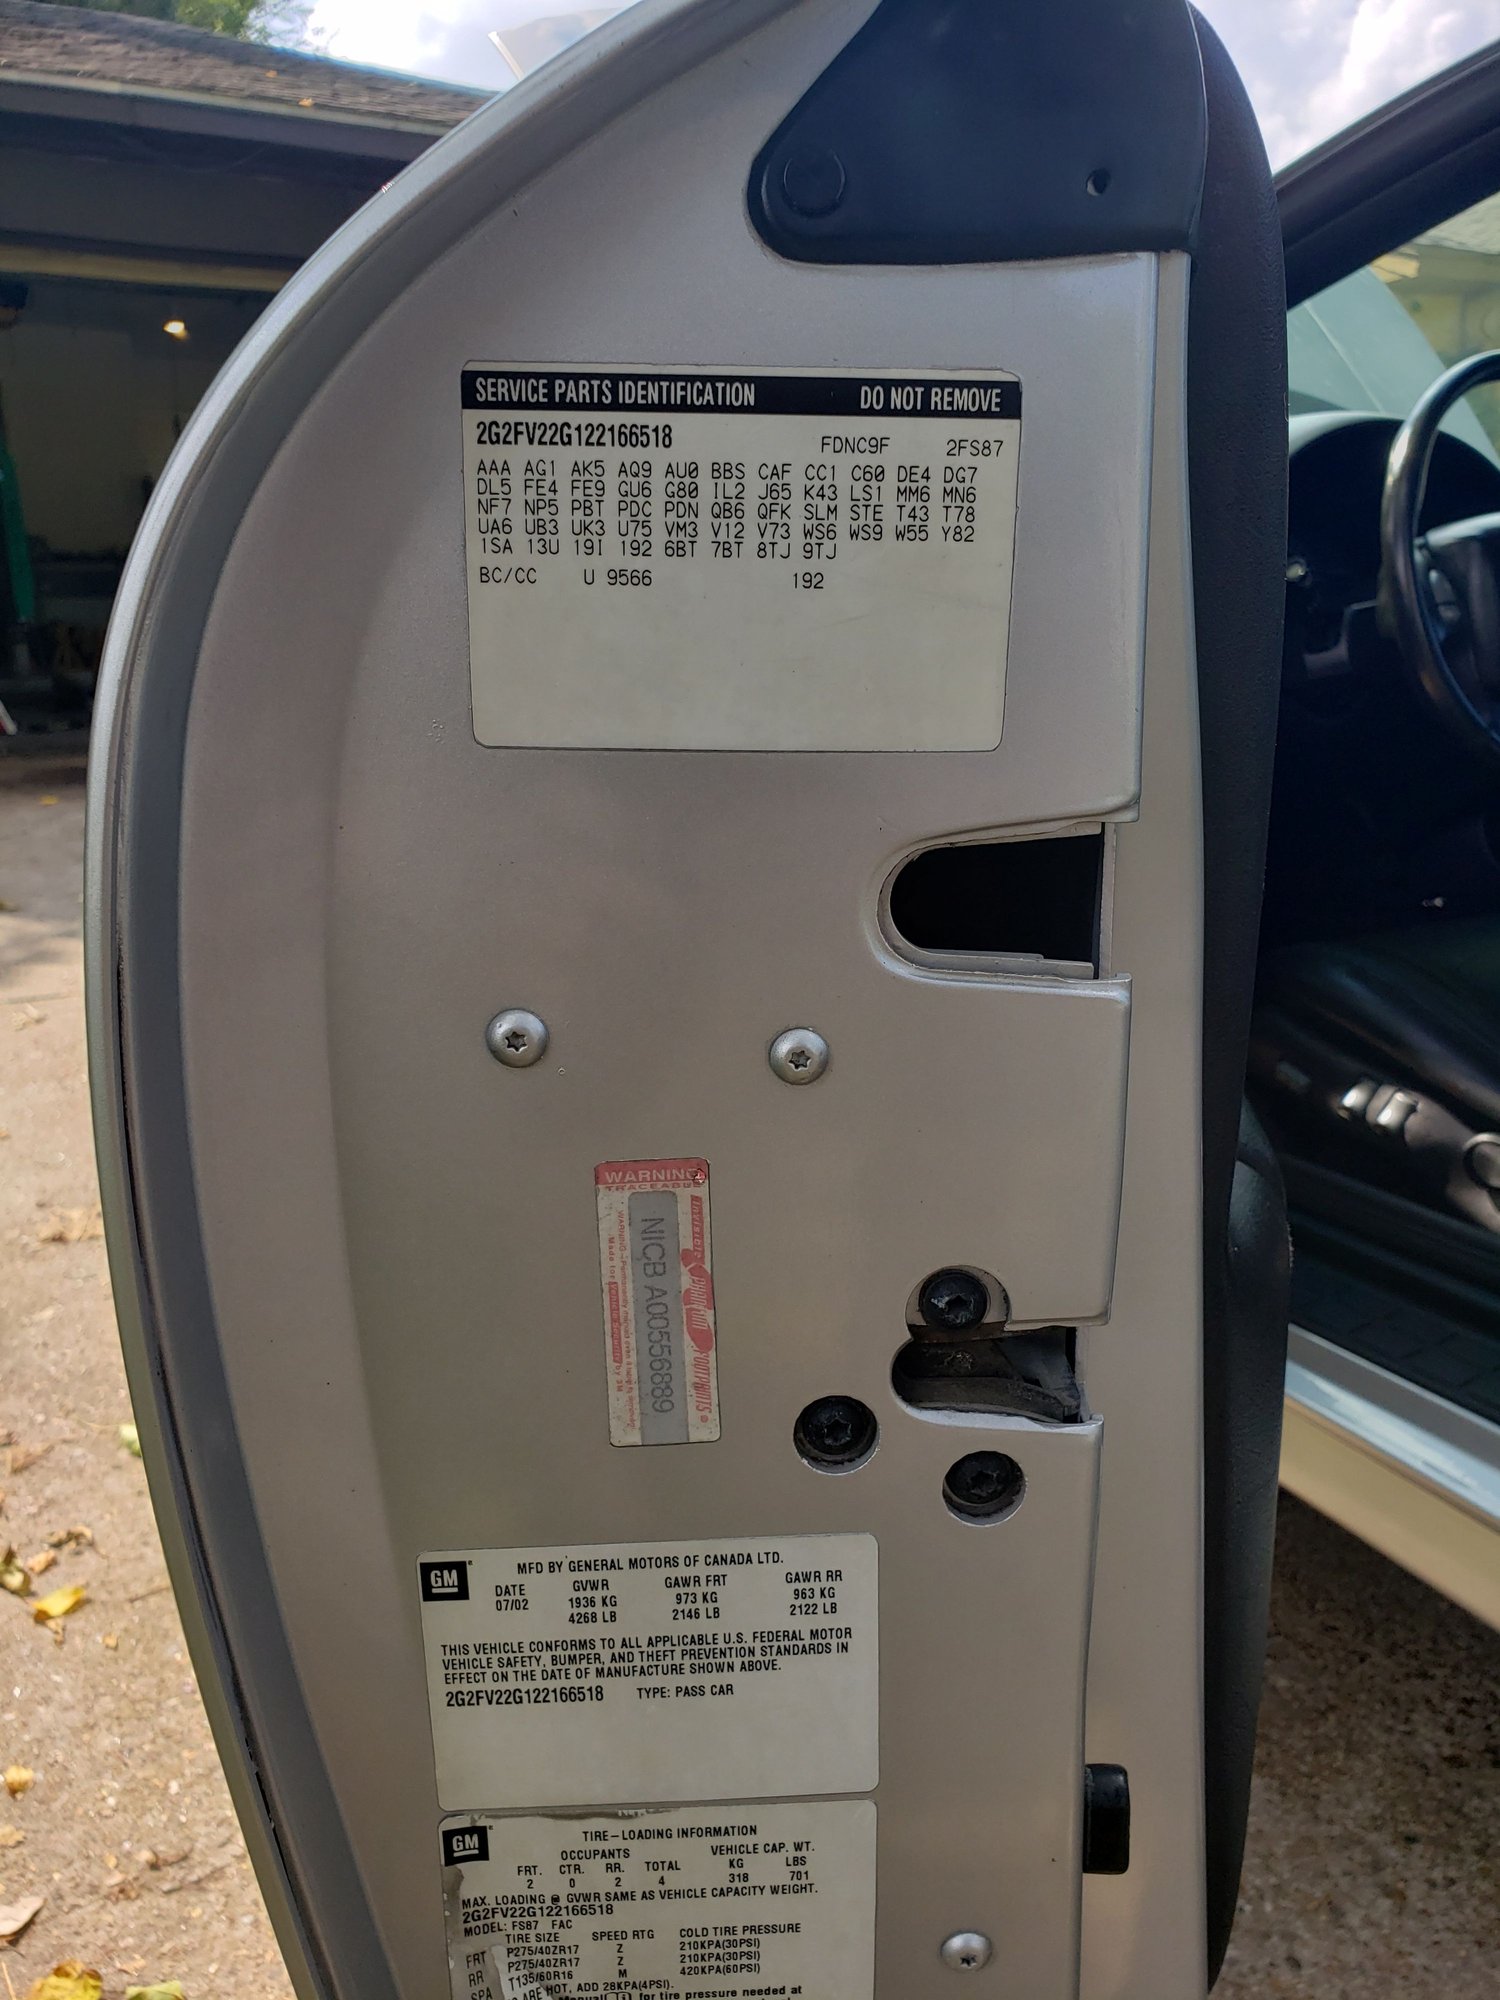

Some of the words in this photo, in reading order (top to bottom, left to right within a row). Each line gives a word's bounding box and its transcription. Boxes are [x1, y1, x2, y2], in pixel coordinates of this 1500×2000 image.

[476, 378, 548, 403] SERVICE
[554, 379, 612, 404] PARTS
[618, 381, 755, 406] IDENTIFICATION
[860, 385, 884, 410] DO
[890, 387, 924, 410] NOT
[930, 388, 1001, 412] REMOVE
[476, 421, 672, 448] 2G2FV22G122166518
[821, 436, 890, 454] FDNC9F
[946, 439, 1004, 457] 2FS87
[477, 459, 511, 476] AAA
[524, 460, 558, 477] AG1
[571, 460, 606, 478] AK5
[618, 461, 652, 479] AQ9
[711, 462, 746, 480] BBS
[758, 463, 792, 481] CAF
[804, 464, 837, 482] CC1
[851, 464, 885, 482] C60
[897, 465, 930, 483] DE4
[943, 466, 978, 484] DG7
[477, 479, 511, 496] DL5
[524, 480, 558, 496] FE4
[571, 480, 606, 497] FE9
[618, 481, 652, 498] GU6
[664, 482, 699, 499] G80
[758, 483, 792, 500] J65
[804, 484, 837, 501] K43
[851, 484, 885, 502] LS1
[897, 485, 930, 502] MM6
[943, 486, 978, 503] MN6
[477, 498, 511, 515] NF7
[524, 499, 558, 516] NP5
[571, 500, 606, 517] PBT
[618, 500, 652, 517] PDC
[664, 501, 699, 518] PDN
[711, 502, 746, 519] QB6
[758, 503, 792, 520] QFK
[804, 504, 837, 521] SLM
[851, 504, 885, 521] STE
[897, 505, 930, 522] T43
[943, 505, 978, 523] T78
[478, 518, 512, 536] UA6
[524, 518, 558, 536] UB3
[571, 519, 606, 537] UK3
[618, 520, 652, 537] U75
[664, 521, 699, 538] VM3
[711, 522, 746, 539] V12
[758, 523, 792, 540] V73
[804, 524, 837, 541] WS6
[851, 524, 885, 541] WS9
[897, 525, 930, 542] W55
[943, 526, 978, 542] Y82
[480, 567, 537, 584] BC/CC
[584, 569, 595, 584] U
[607, 570, 652, 586] 9566
[793, 572, 824, 589] 192
[691, 1201, 703, 1258] Invisible
[641, 1217, 668, 1279] NICB
[643, 1284, 675, 1413] A00556889
[693, 1347, 713, 1413] FOOTPRINTS
[517, 1563, 544, 1574] MFD
[549, 1561, 563, 1574] BY
[569, 1558, 624, 1572] GENERAL
[628, 1556, 680, 1568] MOTORS
[684, 1555, 699, 1567] OF
[704, 1553, 753, 1566] CANADA
[757, 1552, 784, 1564] LTD.
[430, 1569, 459, 1587] GM
[573, 1580, 609, 1592] GVWR
[665, 1576, 701, 1589] GAWR
[706, 1574, 727, 1587] FRT
[786, 1571, 821, 1584] GAWR
[826, 1570, 842, 1582] RR
[495, 1584, 525, 1597] DATE
[676, 1593, 697, 1604] 973
[702, 1592, 718, 1603] KG
[794, 1589, 814, 1600] 963
[820, 1587, 835, 1599] KG
[495, 1599, 529, 1611] 07/02
[569, 1597, 596, 1609] 1936
[602, 1596, 617, 1607] KG
[441, 1644, 469, 1656] THIS
[474, 1642, 524, 1655] VEHICLE
[529, 1640, 596, 1652] CONFORMS
[600, 1638, 615, 1649] TO
[621, 1637, 642, 1649] ALL
[647, 1634, 718, 1647] APPLICABLE
[723, 1633, 747, 1644] U.S.
[752, 1630, 804, 1643] FEDERAL
[809, 1628, 852, 1640] MOTOR
[442, 1658, 493, 1670] VEHICLE
[498, 1656, 546, 1668] SAFETY,
[551, 1653, 605, 1667] BUMPER,
[610, 1652, 634, 1663] AND
[640, 1650, 676, 1662] THEFT
[681, 1647, 755, 1660] PREVENTION
[760, 1643, 832, 1657] STANDARDS
[836, 1642, 849, 1653] IN
[444, 1672, 486, 1684] EFFECT
[492, 1671, 509, 1682] ON
[513, 1670, 537, 1682] THE
[542, 1668, 571, 1680] DATE
[575, 1667, 591, 1679] OF
[596, 1664, 686, 1679] MANUFACTURE
[690, 1660, 735, 1674] SHOWN
[740, 1659, 781, 1671] ABOVE.
[446, 1686, 604, 1707] 2G2FV22G122166518
[637, 1686, 671, 1699] TYPE:
[675, 1686, 706, 1697] PASS
[711, 1684, 734, 1695] CAR
[452, 1834, 479, 1851] GM
[582, 1828, 674, 1842] TIRE-LOADING
[677, 1825, 757, 1838] INFORMATION
[561, 1848, 630, 1861] OCCUPANTS
[711, 1844, 759, 1856] VEHICLE
[764, 1842, 789, 1854] CAP.
[793, 1841, 815, 1852] WT.
[517, 1865, 542, 1876] FRT.
[559, 1864, 584, 1875] CTR.
[606, 1862, 625, 1873] RR.
[645, 1860, 681, 1872] TOTAL
[729, 1858, 744, 1869] KG
[786, 1856, 806, 1867] LBS
[462, 1898, 490, 1909] MAX.
[495, 1894, 546, 1906] LOADING
[567, 1892, 601, 1903] GVWR
[605, 1890, 636, 1902] SAME
[641, 1890, 655, 1901] AS
[660, 1887, 707, 1900] VEHICLE
[711, 1885, 766, 1898] CAPACITY
[770, 1883, 818, 1895] WEIGHT.
[462, 1904, 614, 1924] 2G2FV22G122166518
[464, 1922, 507, 1937] MODEL:
[512, 1920, 538, 1931] FS87
[552, 1919, 573, 1930] FAC
[680, 1925, 709, 1938] COLD
[712, 1924, 738, 1936] TIRE
[742, 1923, 801, 1935] PRESSURE
[506, 1933, 531, 1944] TIRE
[535, 1932, 560, 1942] SIZE
[592, 1930, 628, 1941] SPEED
[632, 1929, 655, 1940] RTG
[466, 1951, 487, 1969] FRT
[507, 1945, 580, 1958] P275/40ZR17
[616, 1943, 623, 1954] Z
[680, 1939, 760, 1951] 210KPA(30PSI)
